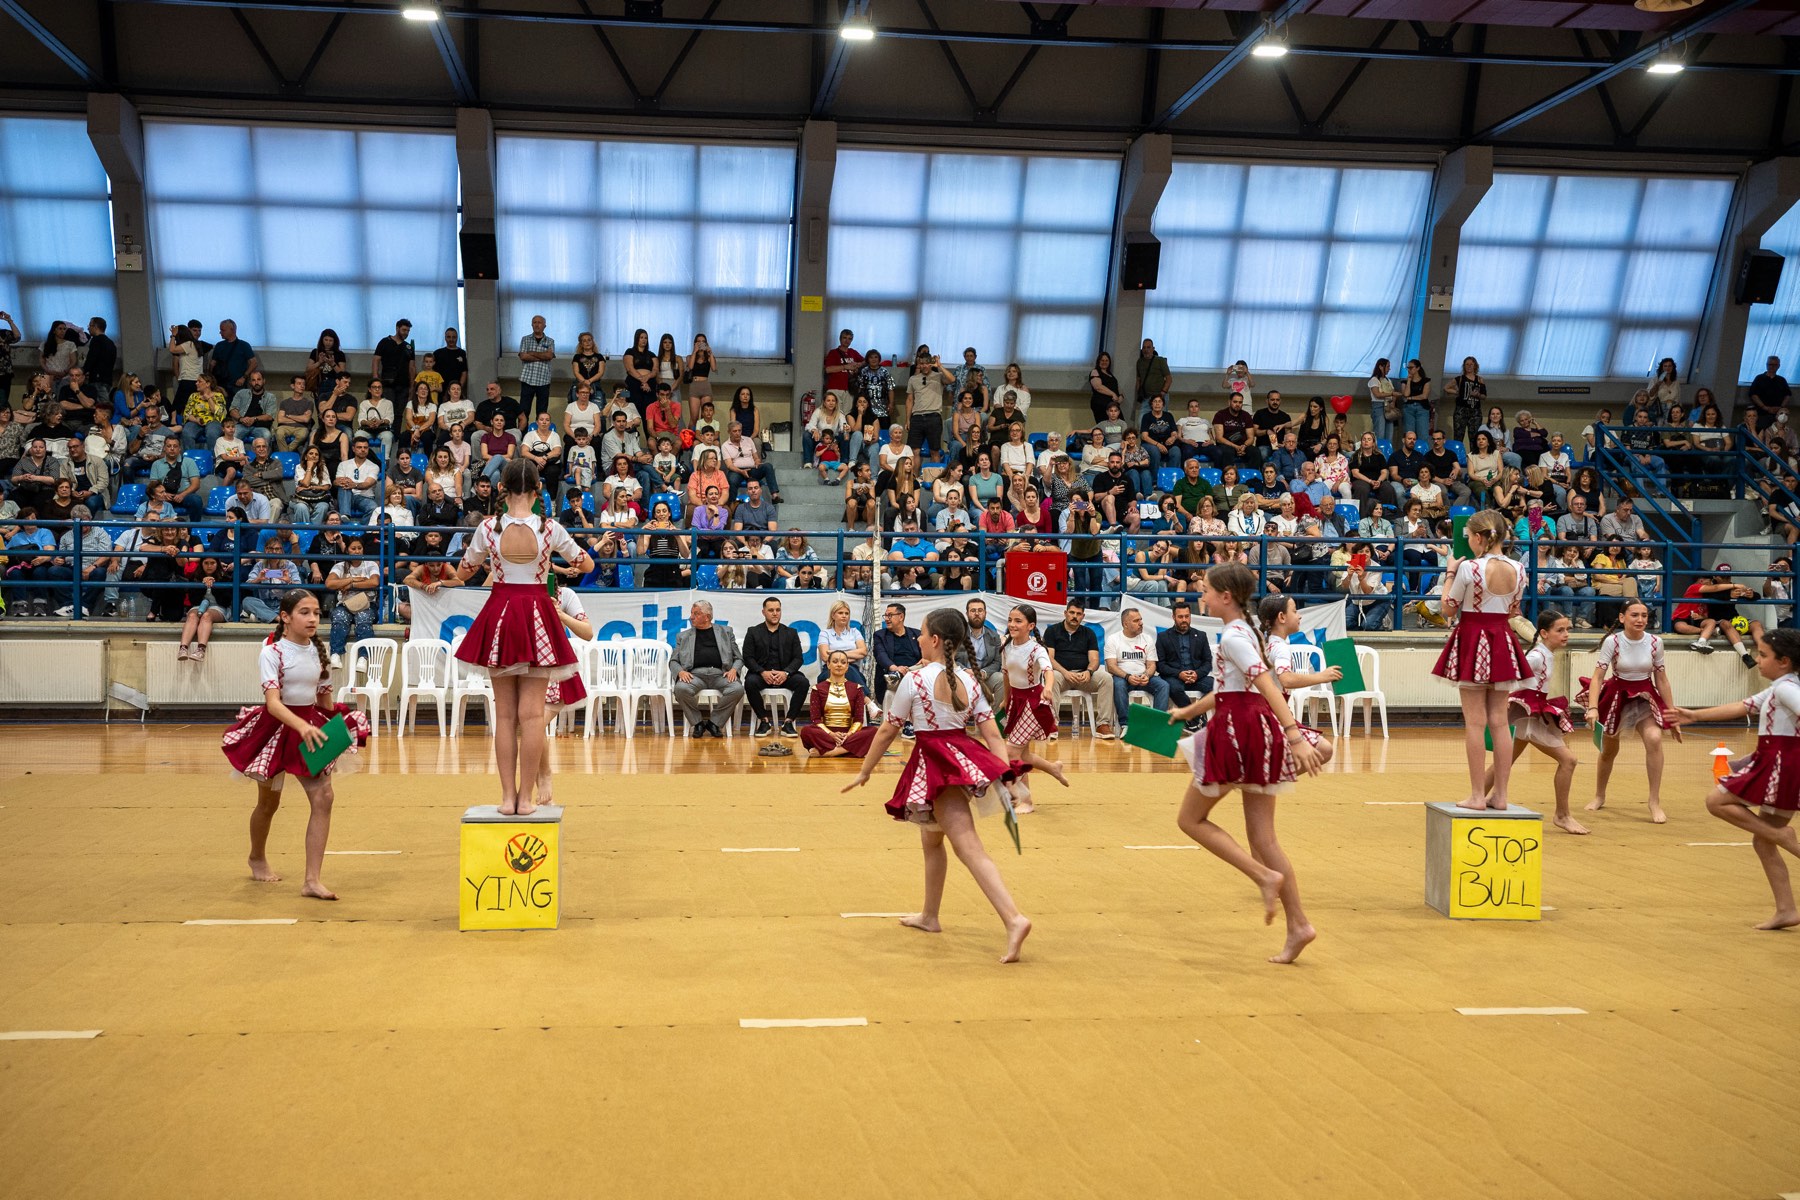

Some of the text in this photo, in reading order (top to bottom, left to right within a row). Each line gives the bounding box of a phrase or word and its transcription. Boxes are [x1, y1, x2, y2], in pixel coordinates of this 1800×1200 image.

[1033, 576, 1042, 588] F
[1121, 651, 1144, 660] PUMA
[1461, 826, 1539, 868] STOP
[465, 871, 553, 912] YING
[1458, 870, 1536, 908] BULL
